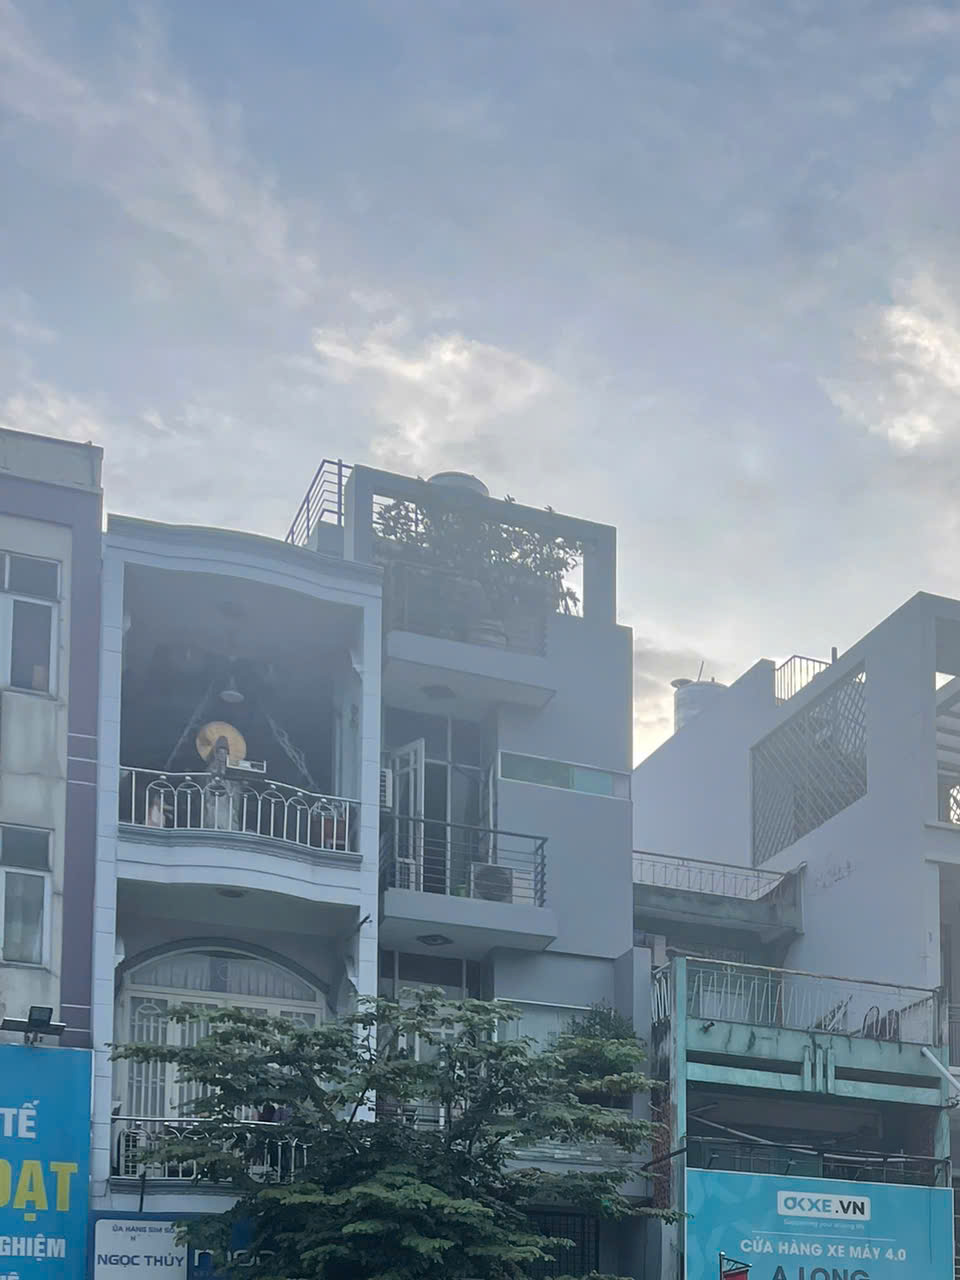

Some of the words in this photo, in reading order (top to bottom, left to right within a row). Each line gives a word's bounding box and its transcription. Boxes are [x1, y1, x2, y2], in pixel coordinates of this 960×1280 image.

[0, 1099, 40, 1138] TẾ
[97, 1254, 140, 1268] NGỌC
[143, 1252, 185, 1268] THỦY
[740, 1236, 773, 1254] CỬA
[777, 1240, 823, 1257] HÀNG
[827, 1245, 845, 1258] XE
[850, 1241, 881, 1260] MÁY
[884, 1248, 906, 1261] 4.0
